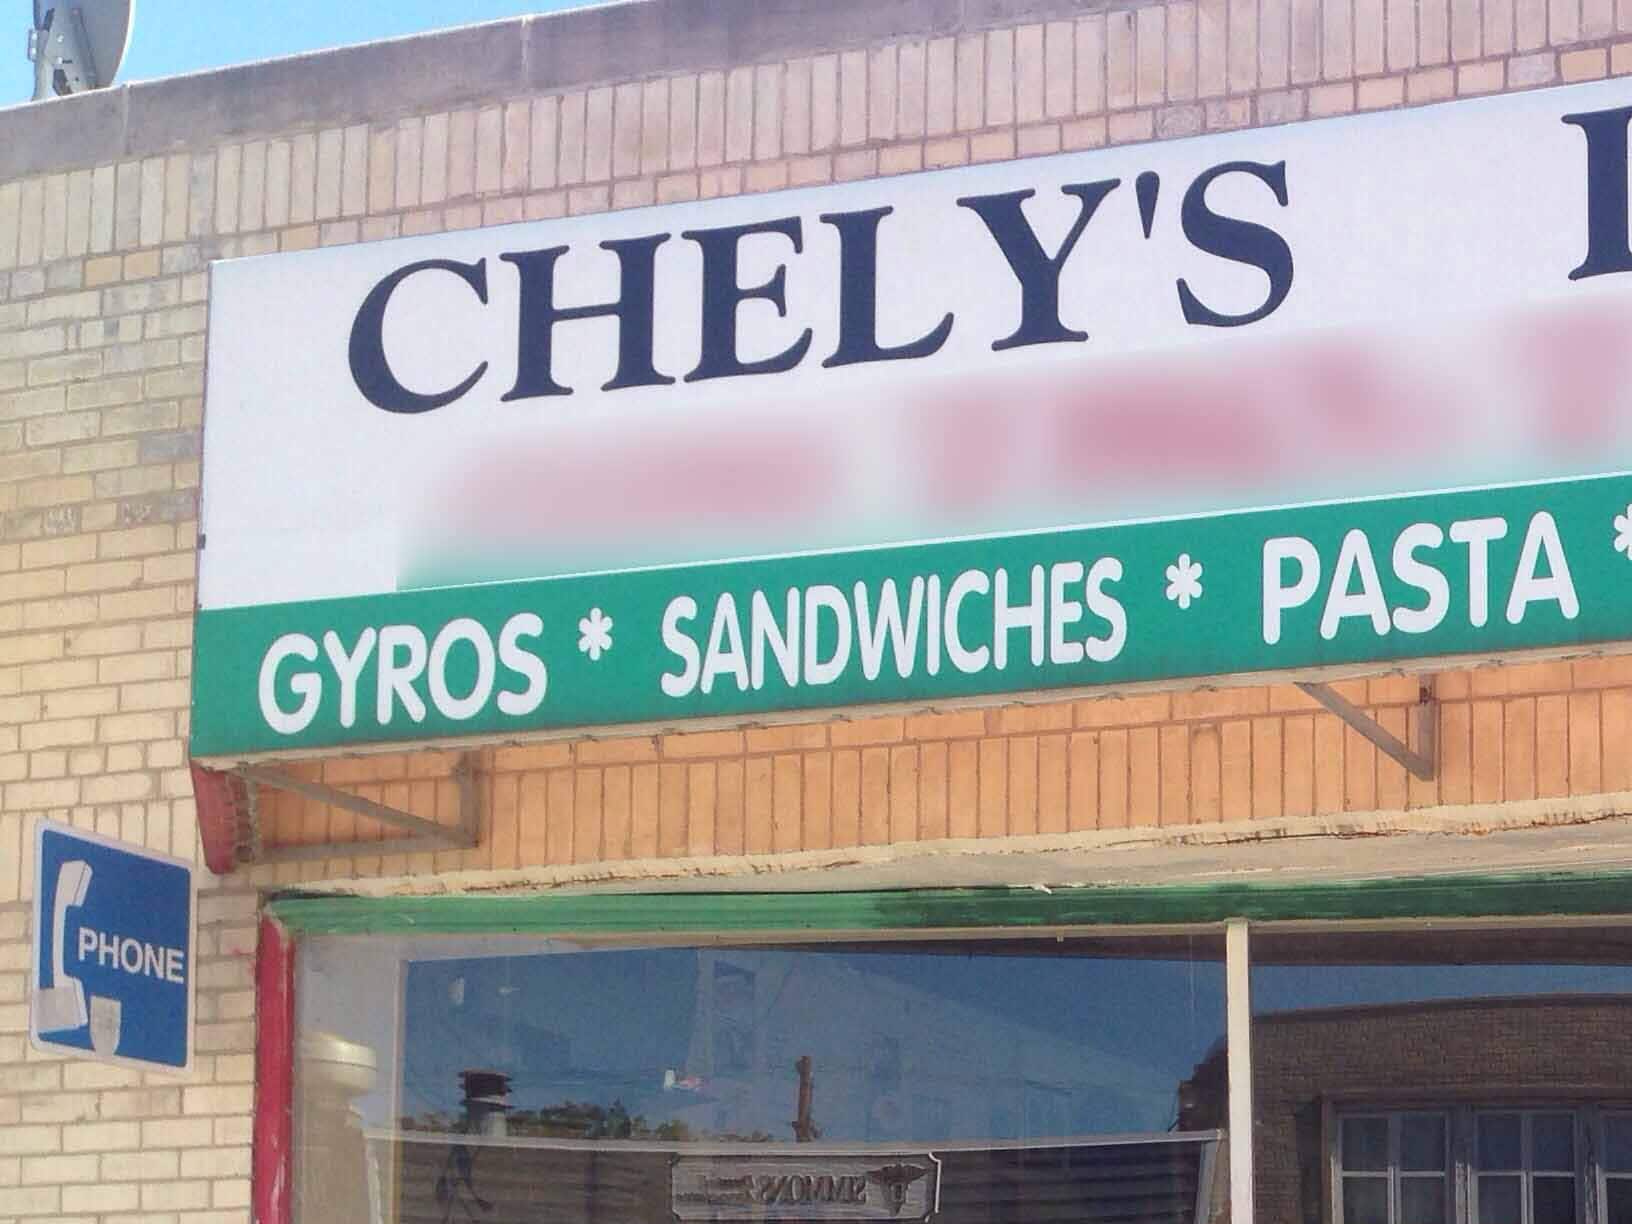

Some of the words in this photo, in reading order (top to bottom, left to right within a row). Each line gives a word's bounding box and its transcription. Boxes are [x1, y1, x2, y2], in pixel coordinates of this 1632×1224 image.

[348, 159, 1293, 413] CHELY'S
[259, 609, 549, 735] GYROS
[661, 557, 1126, 697] SANDWICHES
[1261, 512, 1580, 645] PASTA
[77, 927, 184, 984] PHONE
